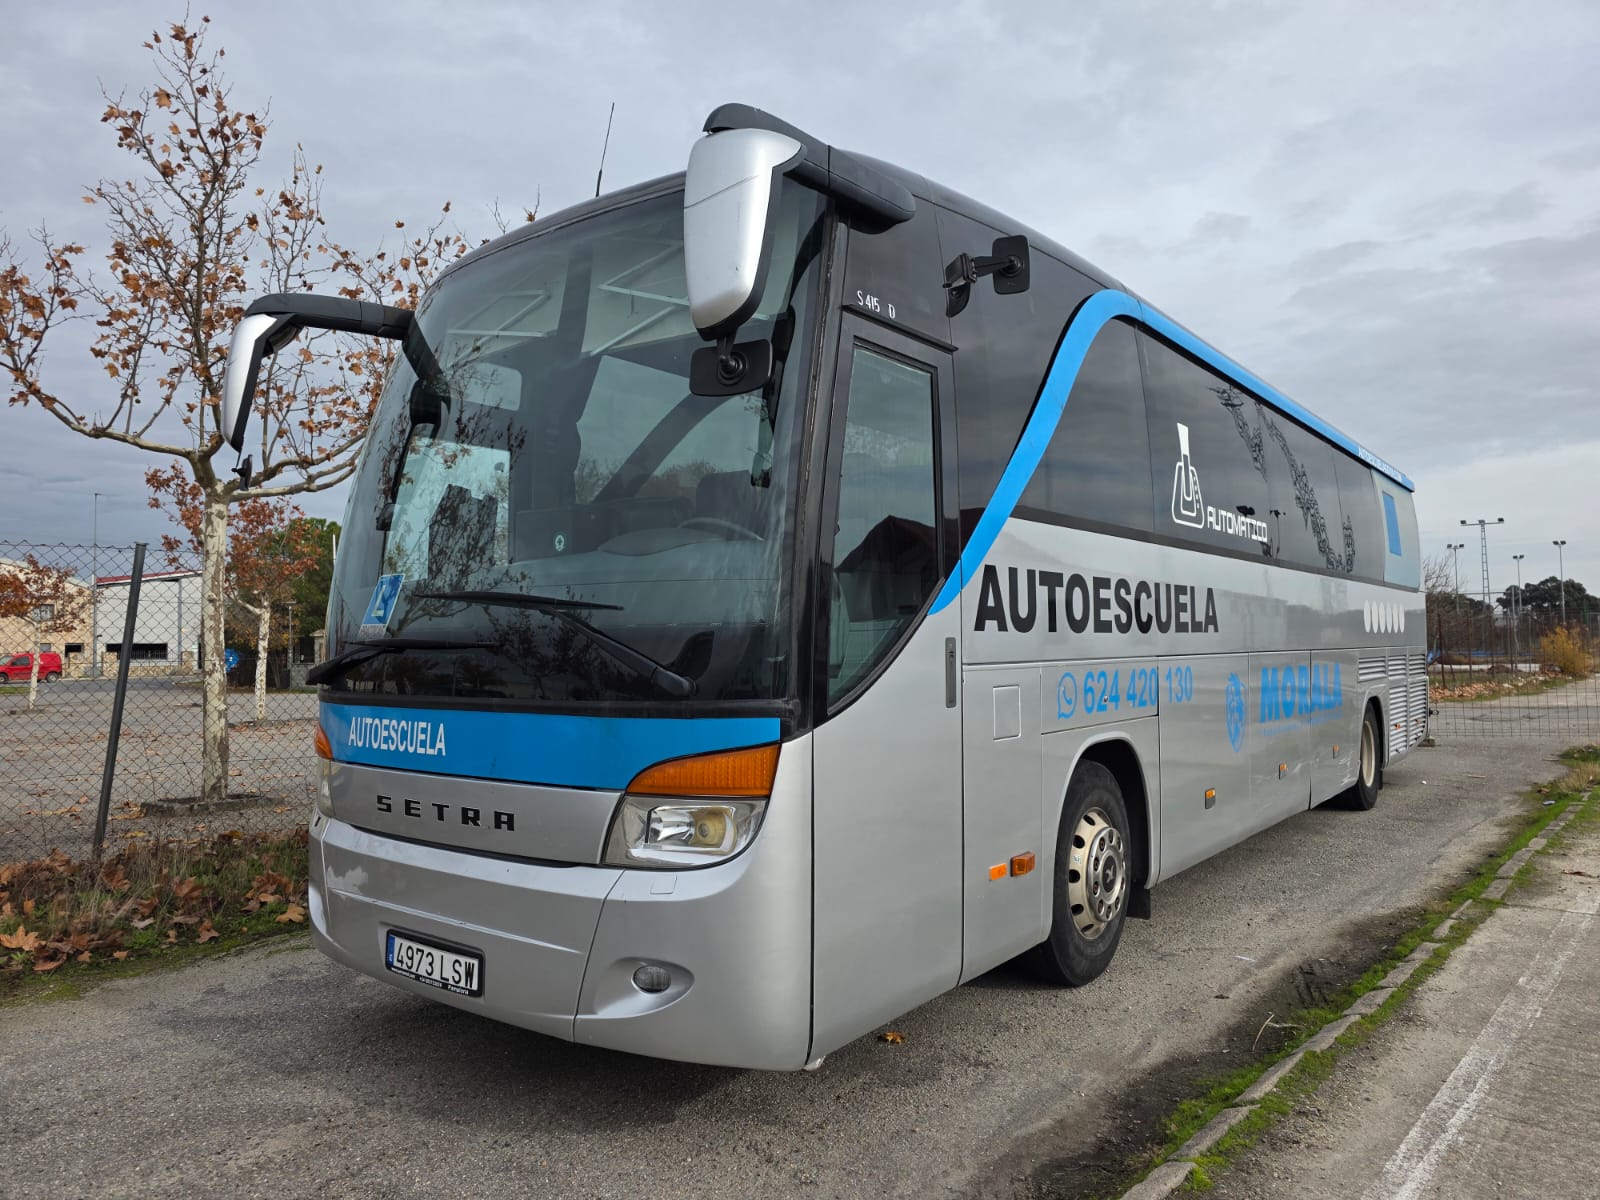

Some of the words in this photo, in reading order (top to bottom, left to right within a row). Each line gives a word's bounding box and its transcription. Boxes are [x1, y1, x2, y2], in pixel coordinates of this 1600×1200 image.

[857, 290, 864, 306] S
[865, 294, 880, 313] 415
[887, 303, 896, 319] D
[1207, 505, 1268, 543] AUTOMATICO
[973, 564, 1219, 634] AUTOESCUELA
[1083, 669, 1121, 715] 624
[1126, 667, 1158, 709] 420
[1165, 665, 1194, 704] 130
[1259, 662, 1343, 724] MORALA
[348, 716, 447, 757] AUTOESCUELA
[376, 794, 516, 832] SETRA
[396, 942, 435, 977] 4973
[440, 954, 475, 989] LSW
